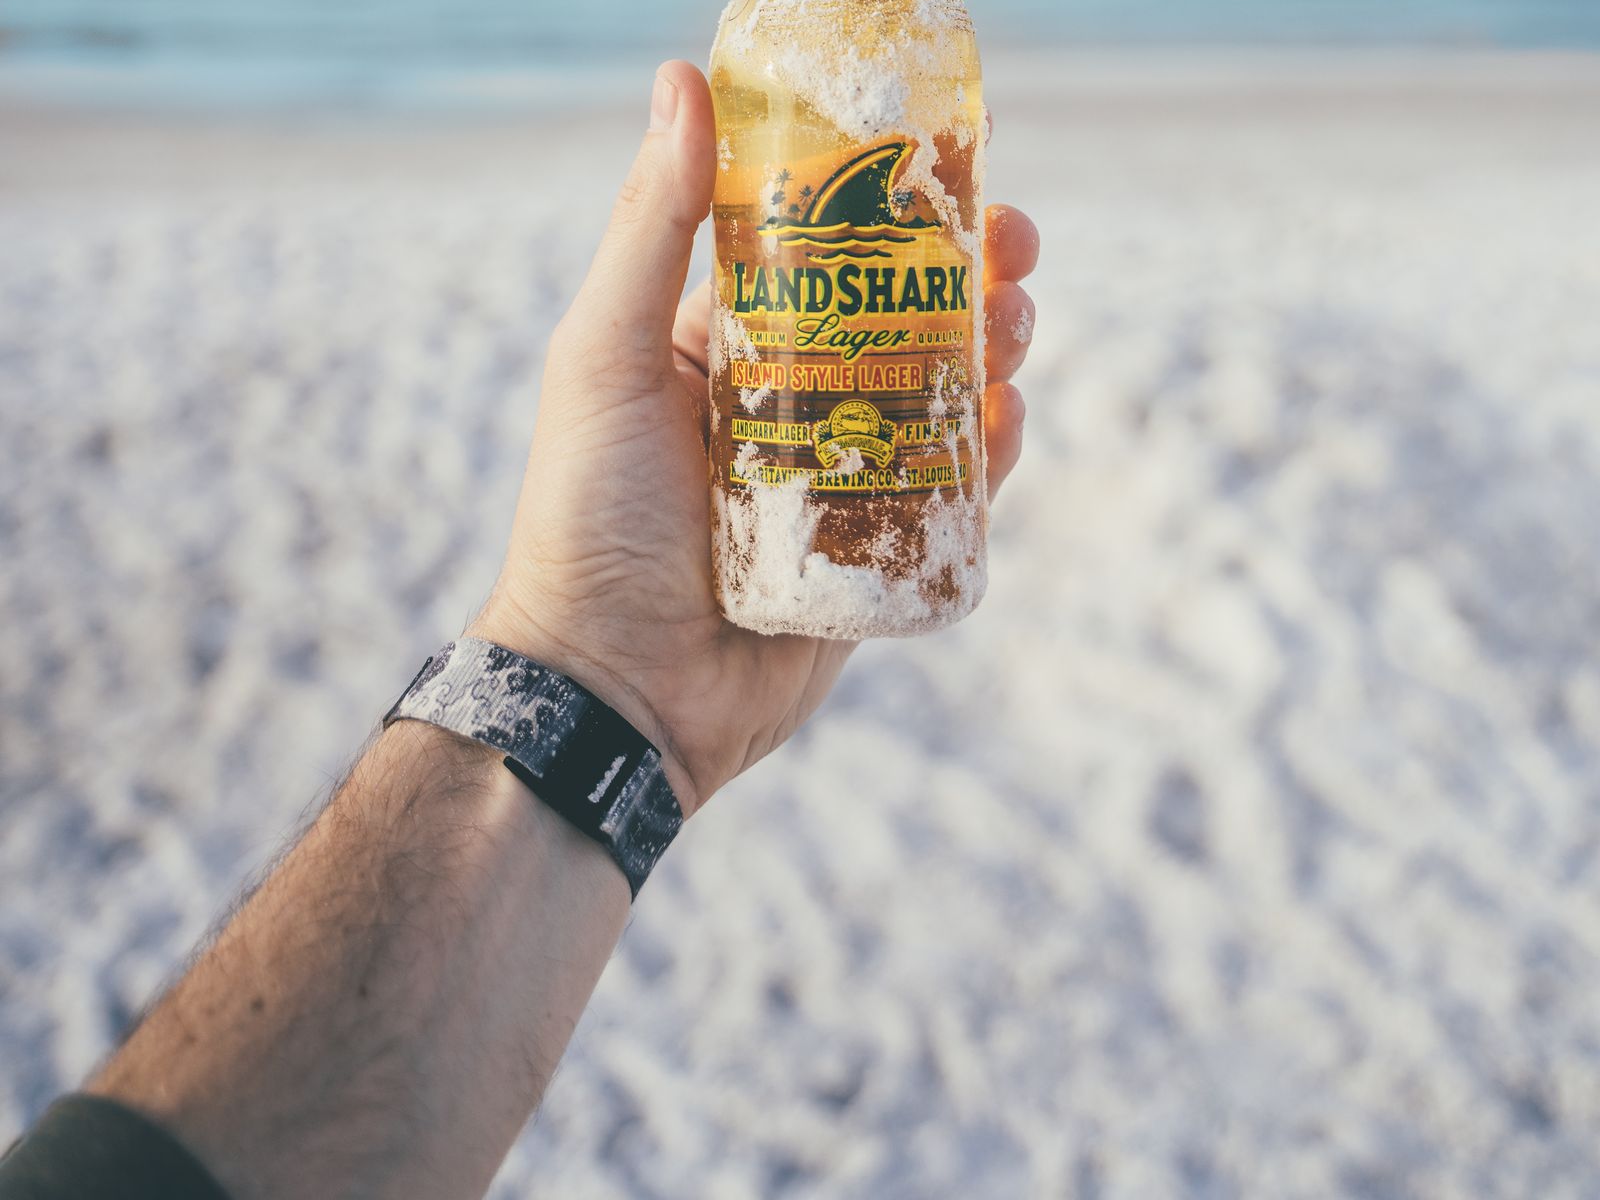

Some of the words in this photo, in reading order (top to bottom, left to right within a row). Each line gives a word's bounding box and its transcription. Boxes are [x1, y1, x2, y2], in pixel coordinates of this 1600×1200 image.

[734, 262, 967, 316] LANDSHARK
[749, 331, 786, 344] EMIUM
[795, 313, 910, 361] Lager
[918, 330, 963, 344] QUALITY
[732, 361, 786, 388] ISLAND
[791, 364, 854, 391] STYLE
[859, 364, 921, 390] LAGER
[733, 420, 774, 439] LANDSHARK
[779, 424, 808, 441] LAGER
[905, 422, 941, 441] FINS
[816, 470, 874, 487] BREWING
[877, 469, 896, 486] CO.
